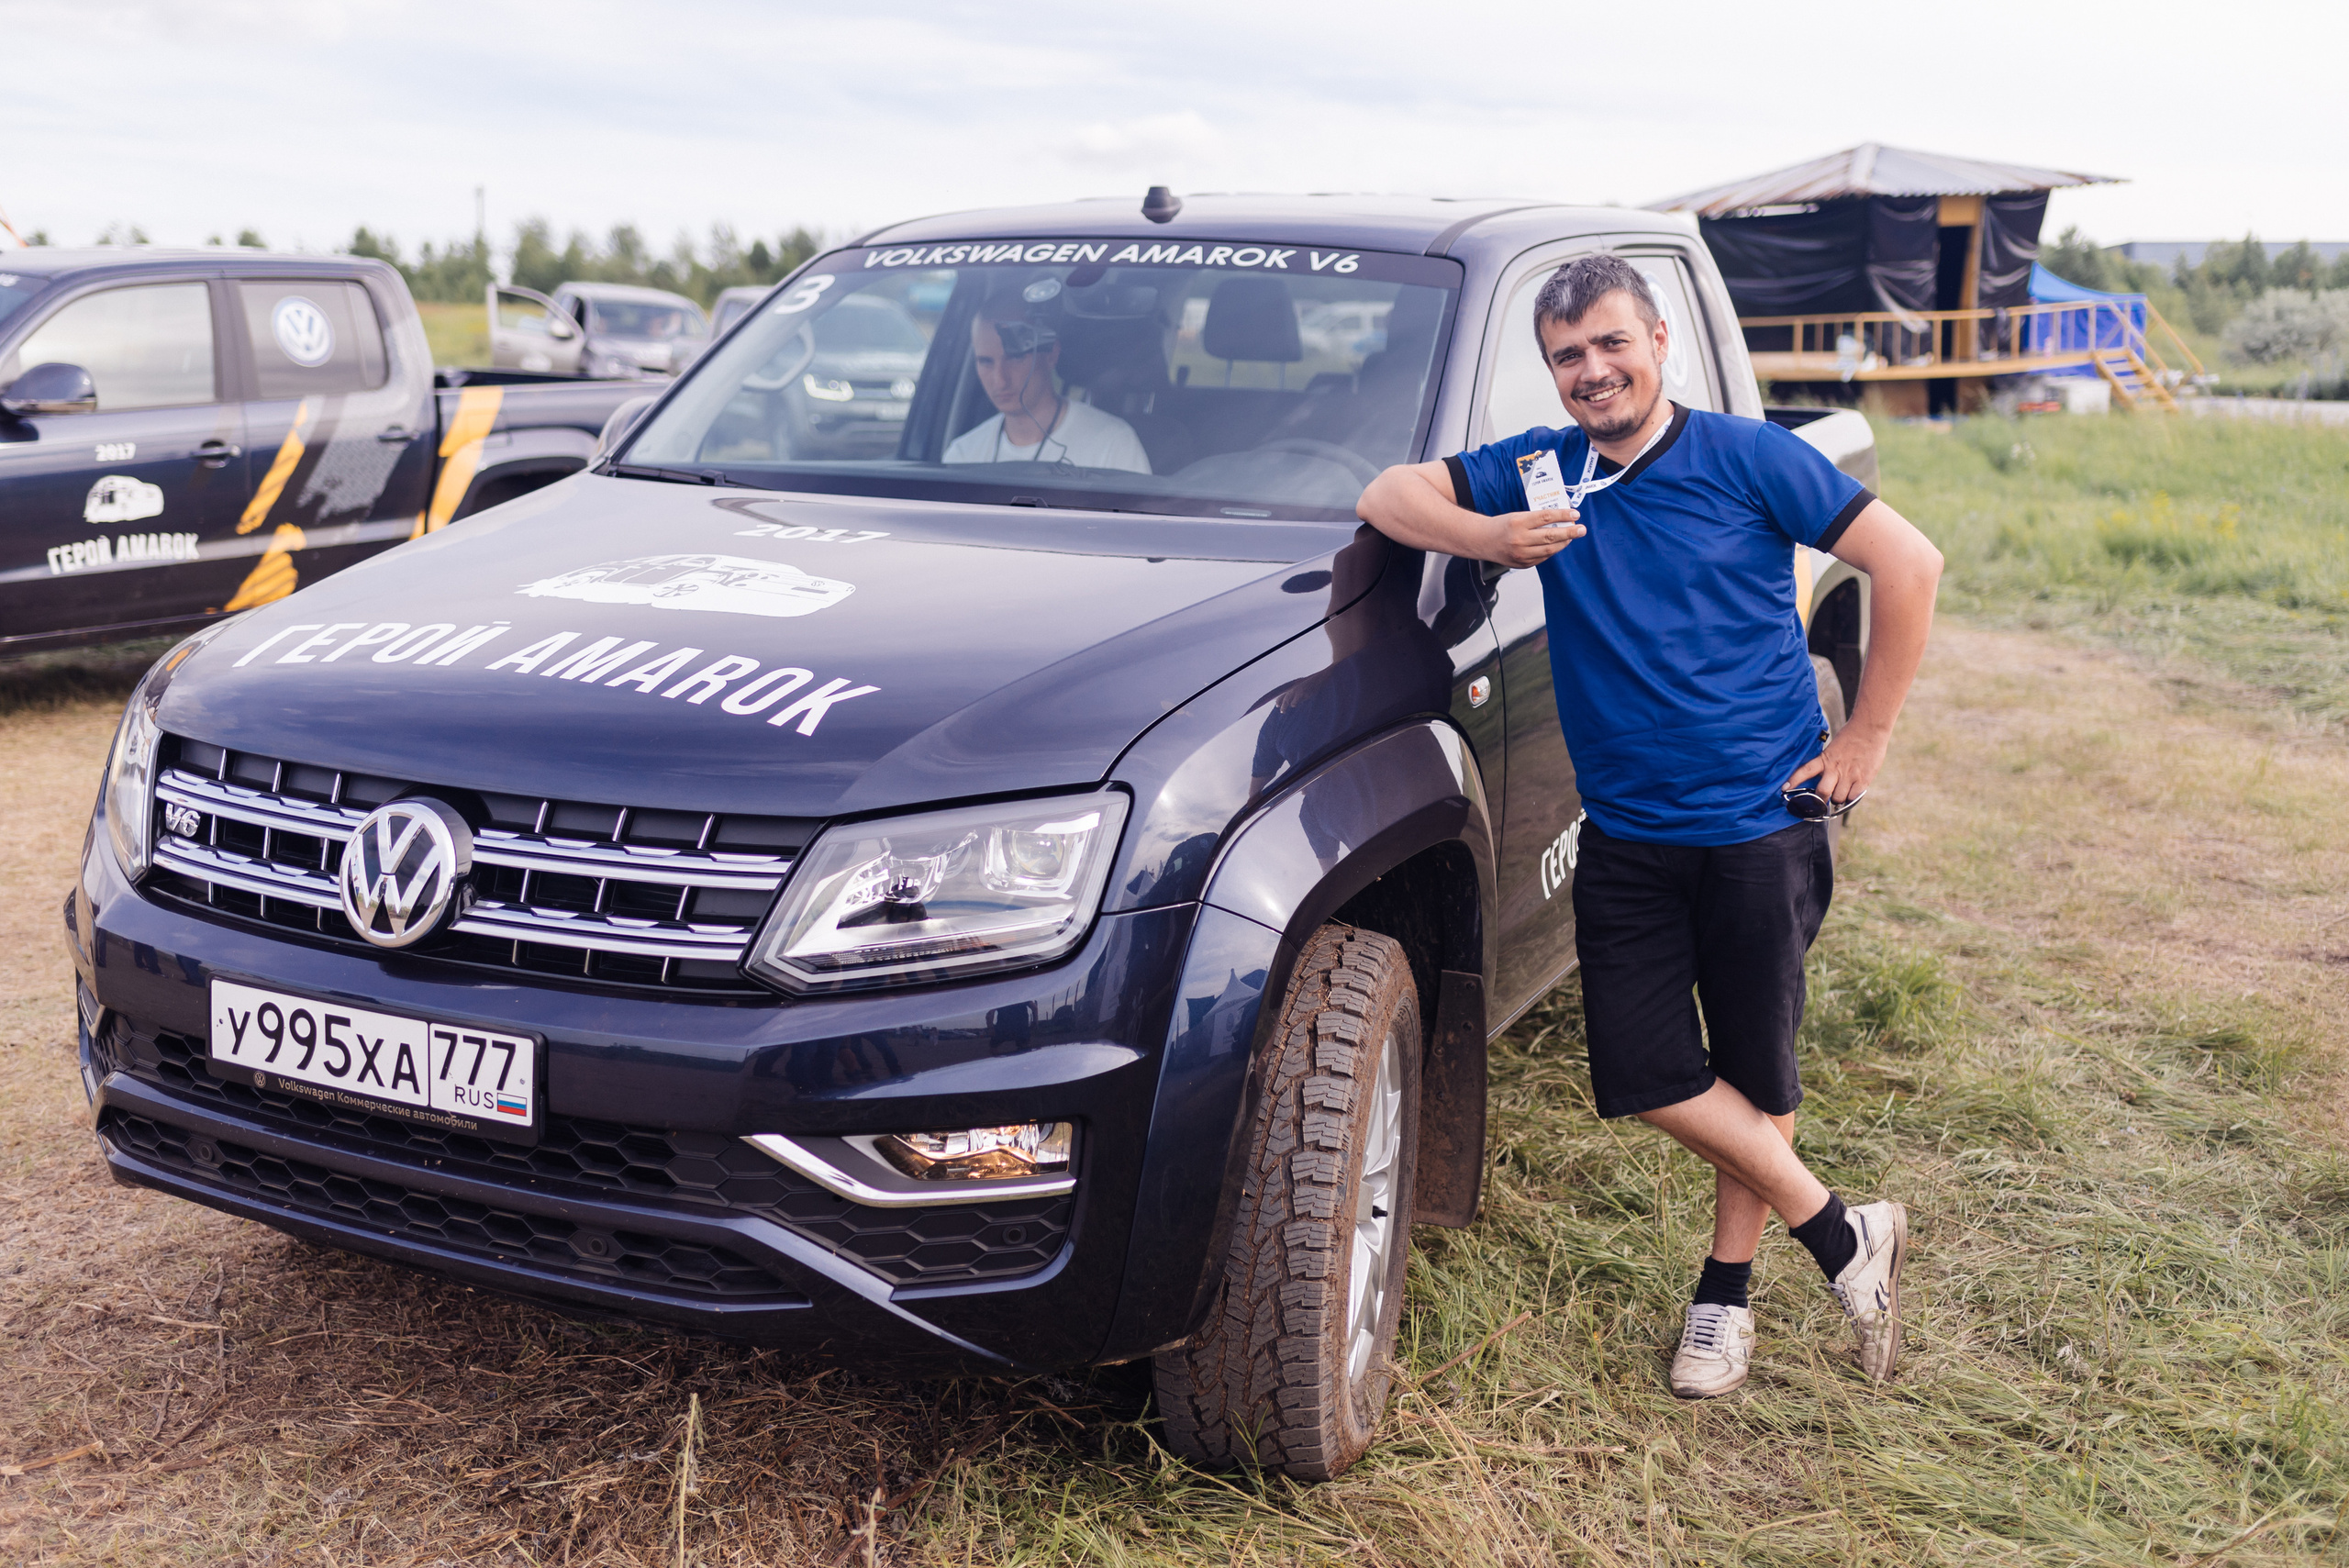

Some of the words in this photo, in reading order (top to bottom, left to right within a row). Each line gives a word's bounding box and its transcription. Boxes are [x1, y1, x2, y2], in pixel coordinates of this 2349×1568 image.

[863, 243, 1108, 269] VOLKSWAGEN
[1109, 243, 1297, 269] AMAROK
[1309, 250, 1361, 273] V6
[774, 273, 836, 315] 3
[95, 441, 137, 462] 2017
[733, 523, 891, 544] 2017
[47, 534, 113, 575] ГЕРОЙ
[116, 531, 200, 563] AMAROK
[232, 621, 512, 668] ГЕРОЙ
[484, 631, 882, 737] AMAROK
[165, 804, 201, 838] V6
[228, 1001, 421, 1095] У995ХА
[434, 1029, 517, 1091] 777
[278, 1077, 336, 1102] Volkswagen
[337, 1091, 411, 1118] Коммерческие
[412, 1108, 478, 1131] автомобили
[454, 1084, 495, 1109] RUS
